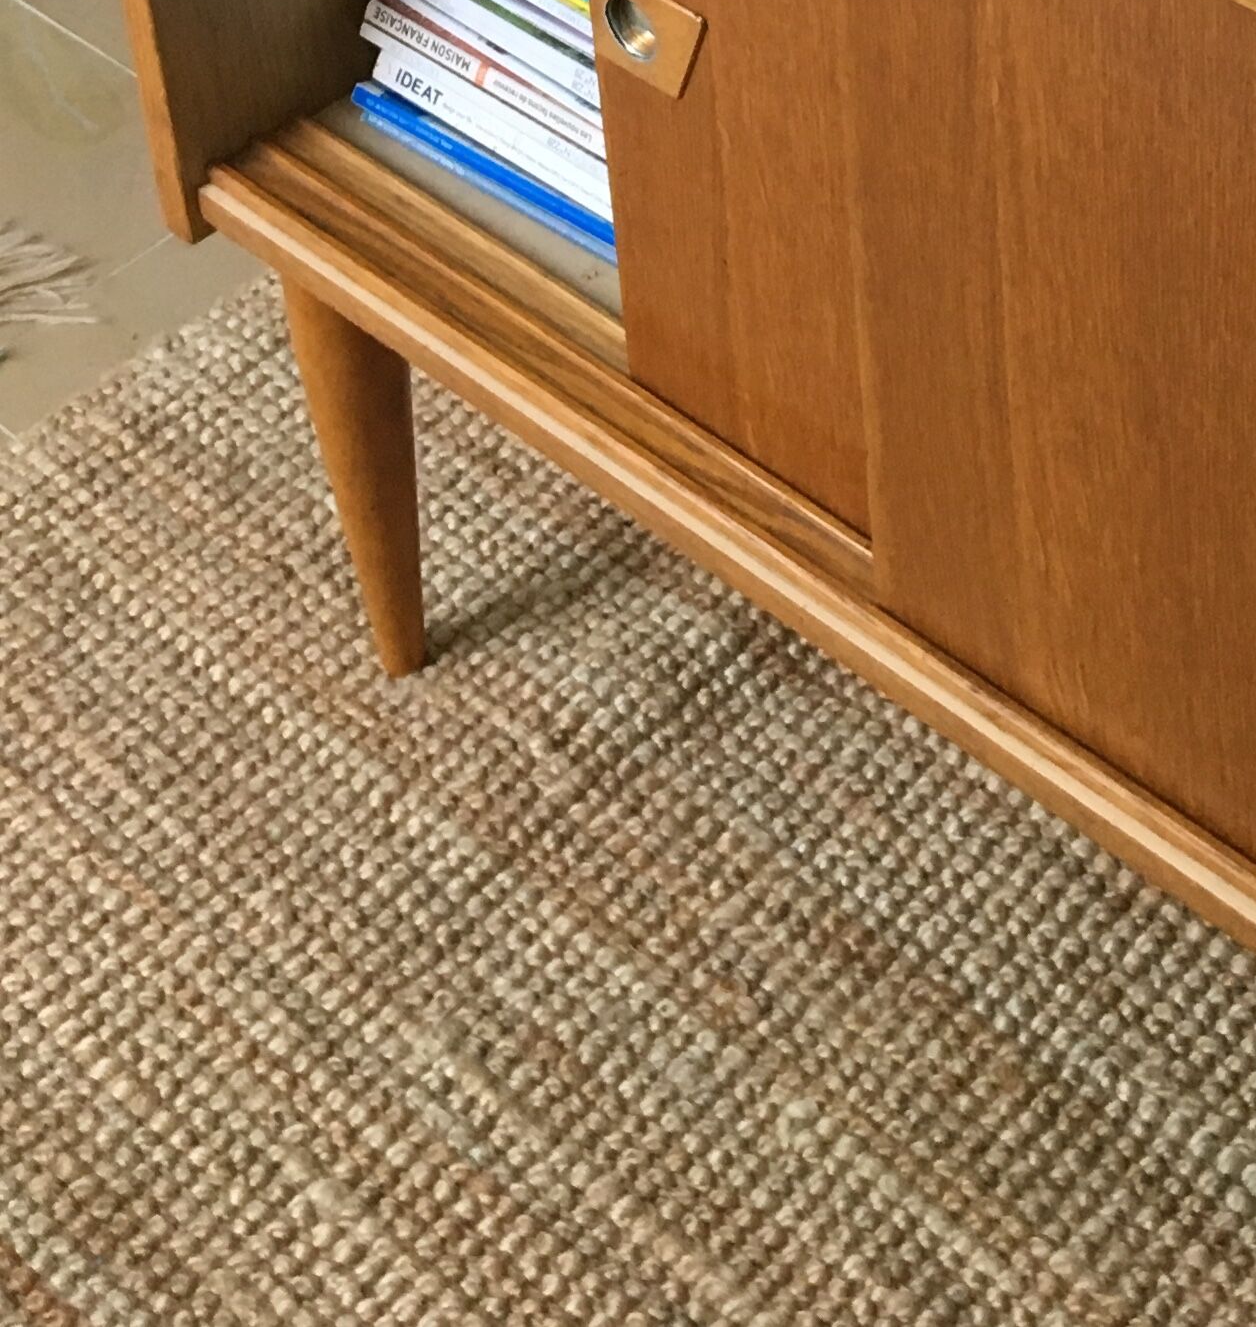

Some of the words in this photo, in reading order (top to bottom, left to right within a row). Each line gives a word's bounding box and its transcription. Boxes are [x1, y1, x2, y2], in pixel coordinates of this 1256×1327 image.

[372, 2, 428, 50] FRANÇAISE
[431, 37, 469, 76] MAISON
[395, 68, 444, 106] IDEAT
[516, 87, 525, 104] de
[577, 125, 592, 145] Les
